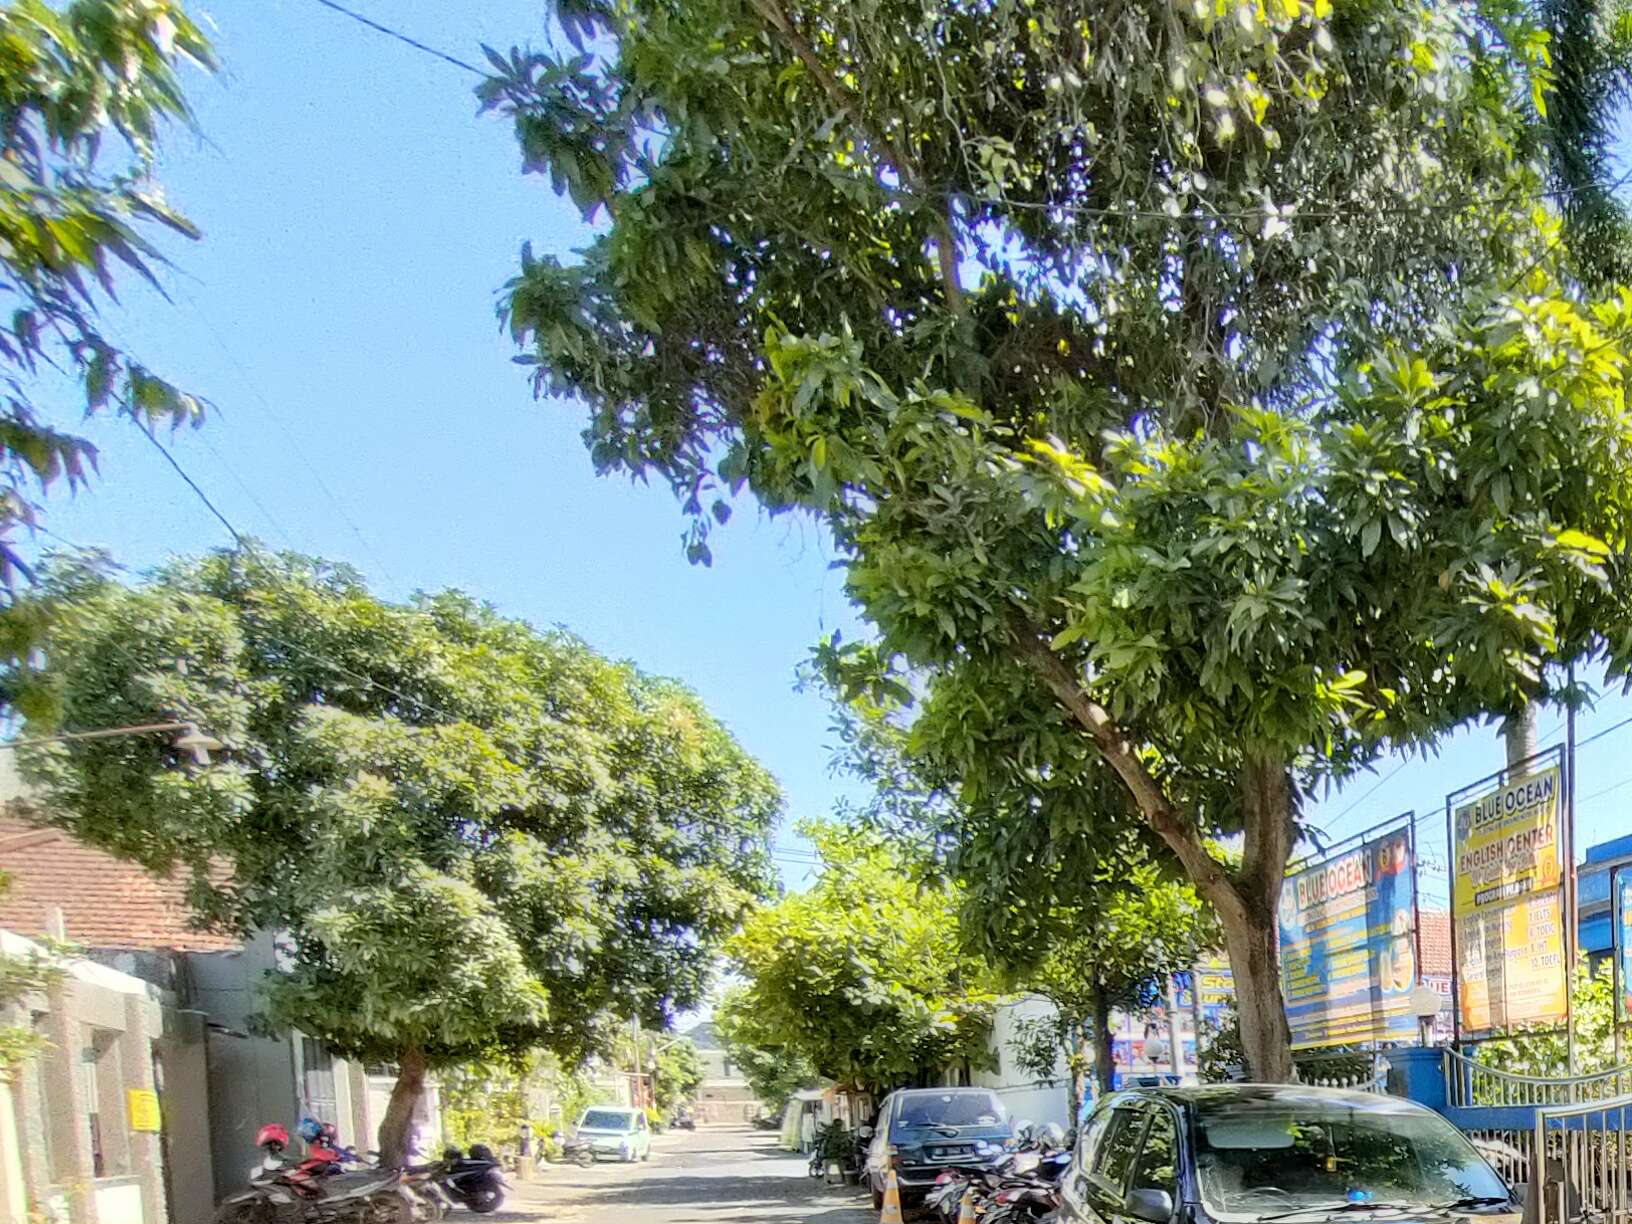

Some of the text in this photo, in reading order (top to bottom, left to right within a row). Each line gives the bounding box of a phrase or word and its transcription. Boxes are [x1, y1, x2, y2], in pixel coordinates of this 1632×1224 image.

[1475, 797, 1502, 824] BLUE
[1505, 775, 1554, 811] OCEAN
[1298, 849, 1372, 909] BLUE OCEAN
[1461, 843, 1503, 871] ENGLISH
